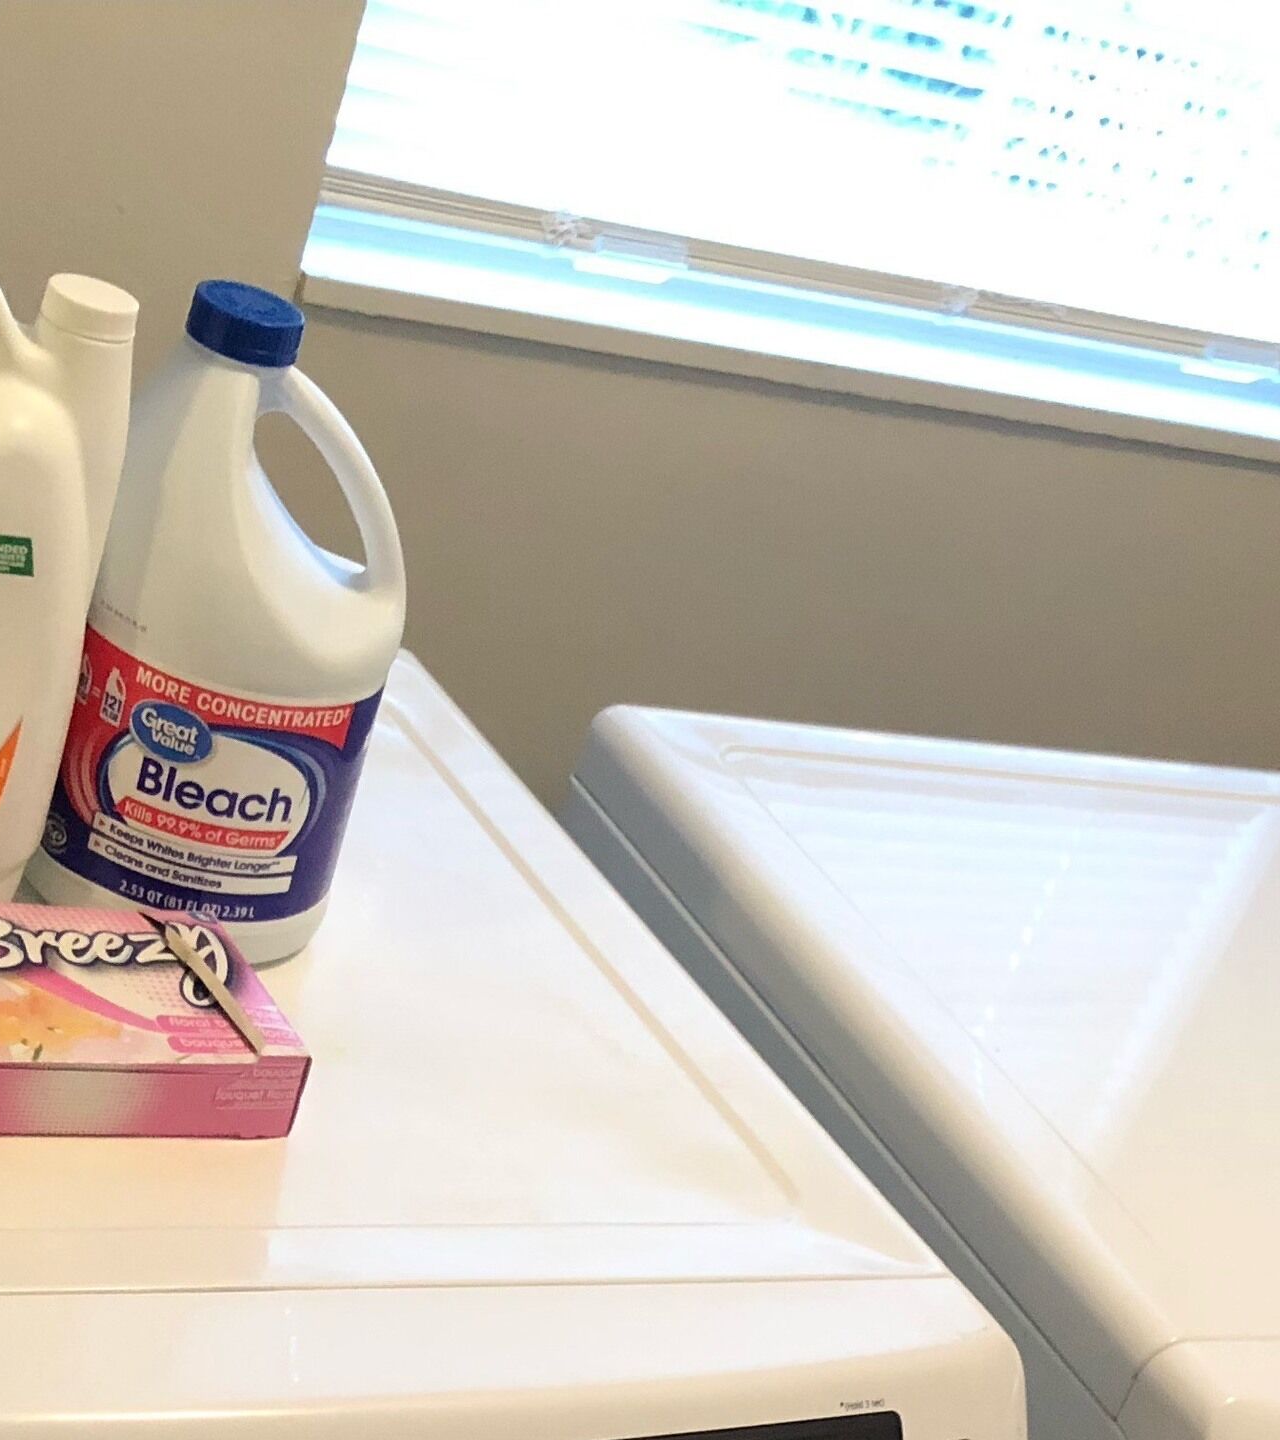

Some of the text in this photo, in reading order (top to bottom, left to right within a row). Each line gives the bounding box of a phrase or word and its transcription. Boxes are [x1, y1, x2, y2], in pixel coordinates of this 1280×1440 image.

[136, 666, 192, 704] MORE
[141, 708, 198, 744] Great
[151, 729, 196, 755] Value
[137, 756, 292, 822] Bleach
[123, 799, 153, 822] Kills
[156, 813, 202, 838] 99.9%
[205, 829, 223, 843] of
[109, 821, 144, 846] Keeps
[146, 837, 185, 861] Whites
[187, 851, 233, 870] Brighter
[104, 843, 222, 888] Cleans and Sanitizes
[119, 880, 145, 898] 2.53
[147, 890, 163, 904] QT
[163, 893, 183, 910] (81
[185, 900, 198, 913] FL
[222, 905, 247, 918] 2.39
[249, 906, 255, 919] L
[169, 1016, 210, 1029] floral
